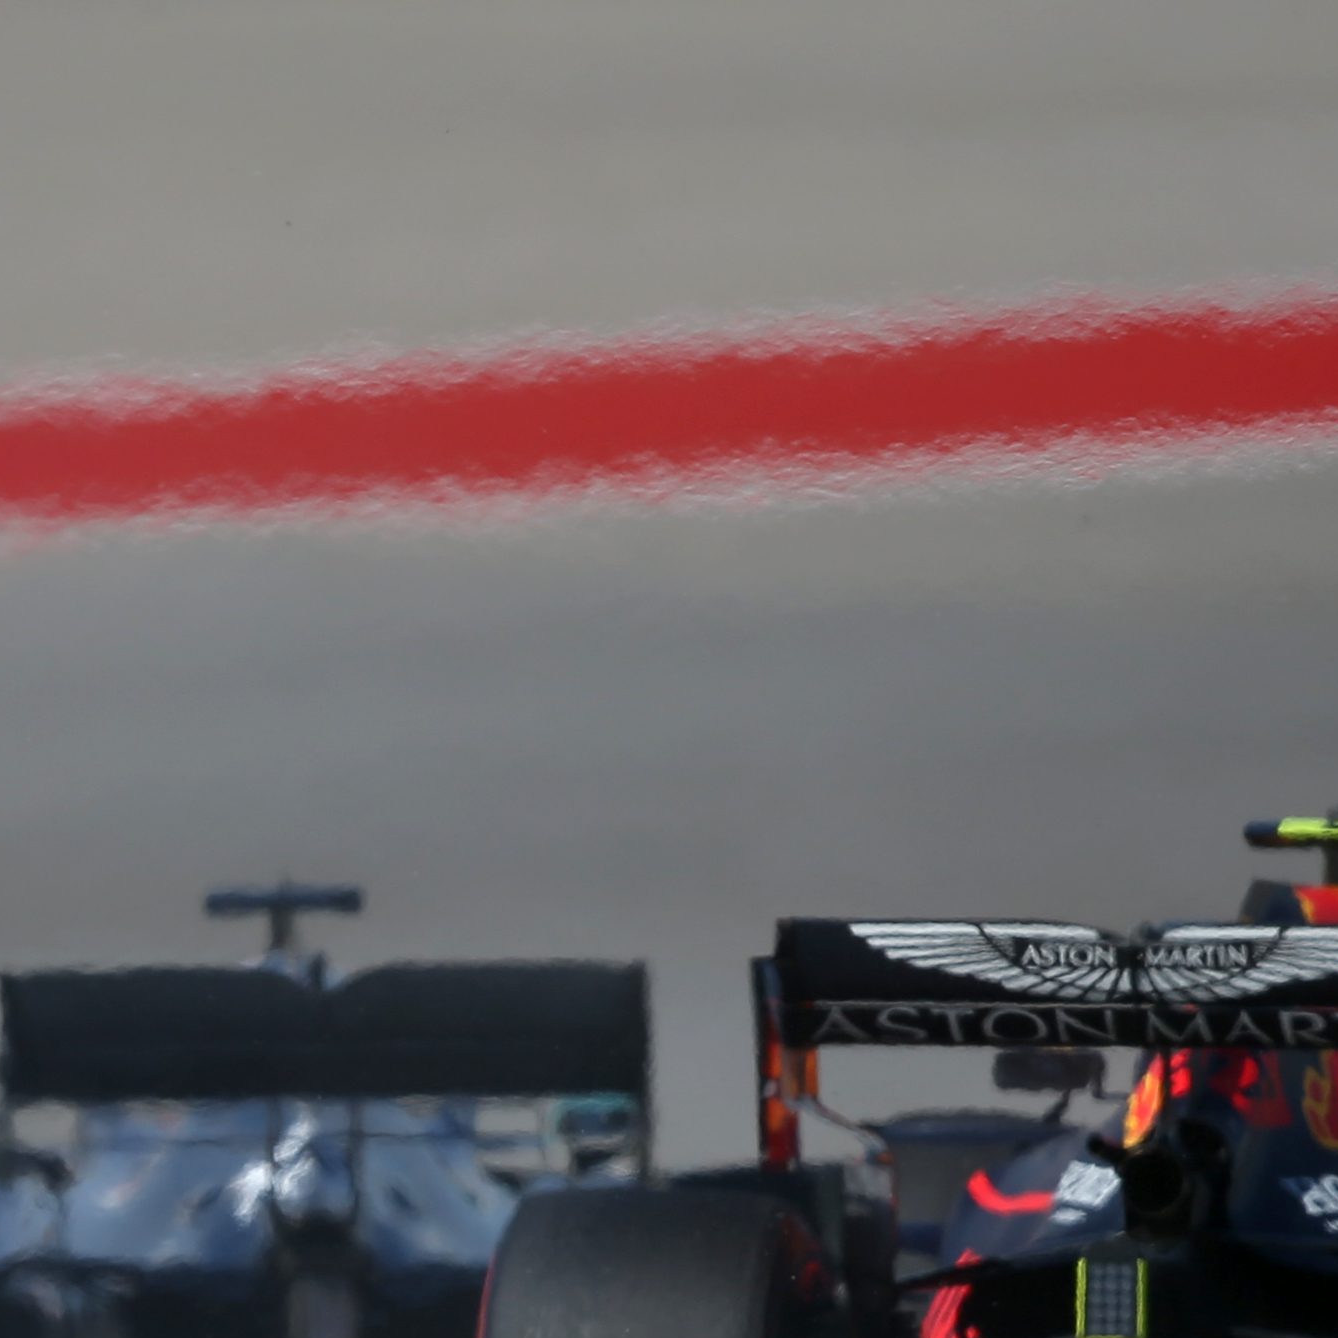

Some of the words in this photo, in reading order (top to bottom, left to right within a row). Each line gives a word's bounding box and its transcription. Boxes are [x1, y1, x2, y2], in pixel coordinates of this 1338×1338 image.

[1021, 943, 1118, 967] ASTON
[1145, 944, 1248, 967] MARTIN
[812, 1005, 1117, 1043] ASTON
